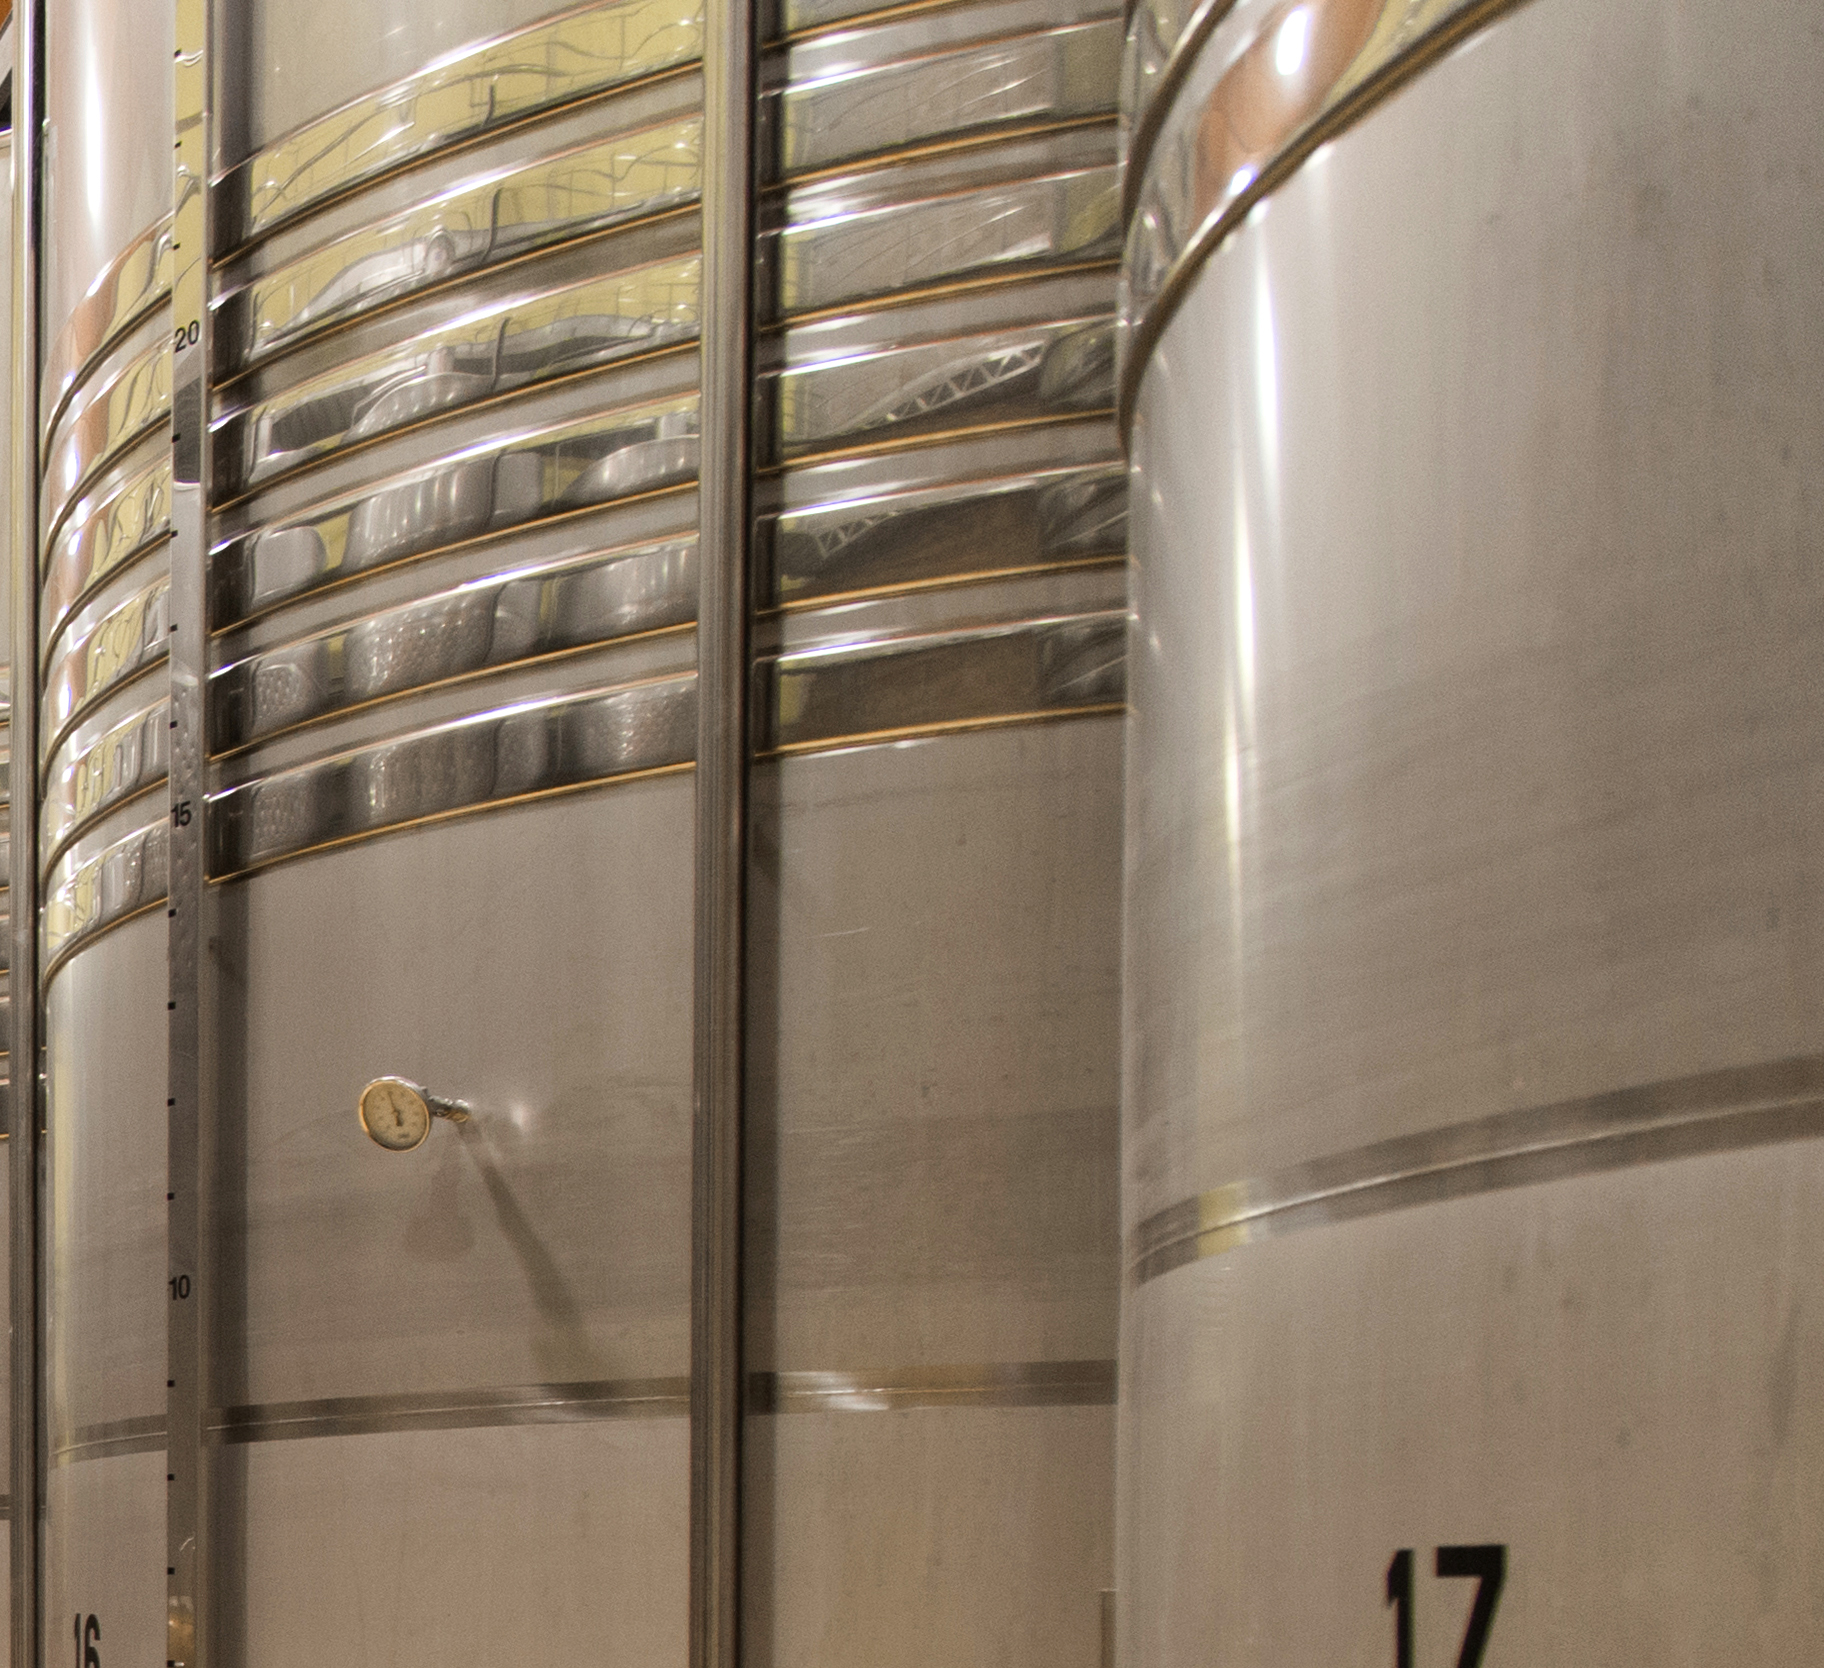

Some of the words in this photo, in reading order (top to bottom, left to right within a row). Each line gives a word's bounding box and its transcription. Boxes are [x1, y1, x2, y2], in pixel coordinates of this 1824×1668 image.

[174, 320, 200, 353] 20
[170, 801, 192, 828] 15
[168, 1274, 191, 1301] 10
